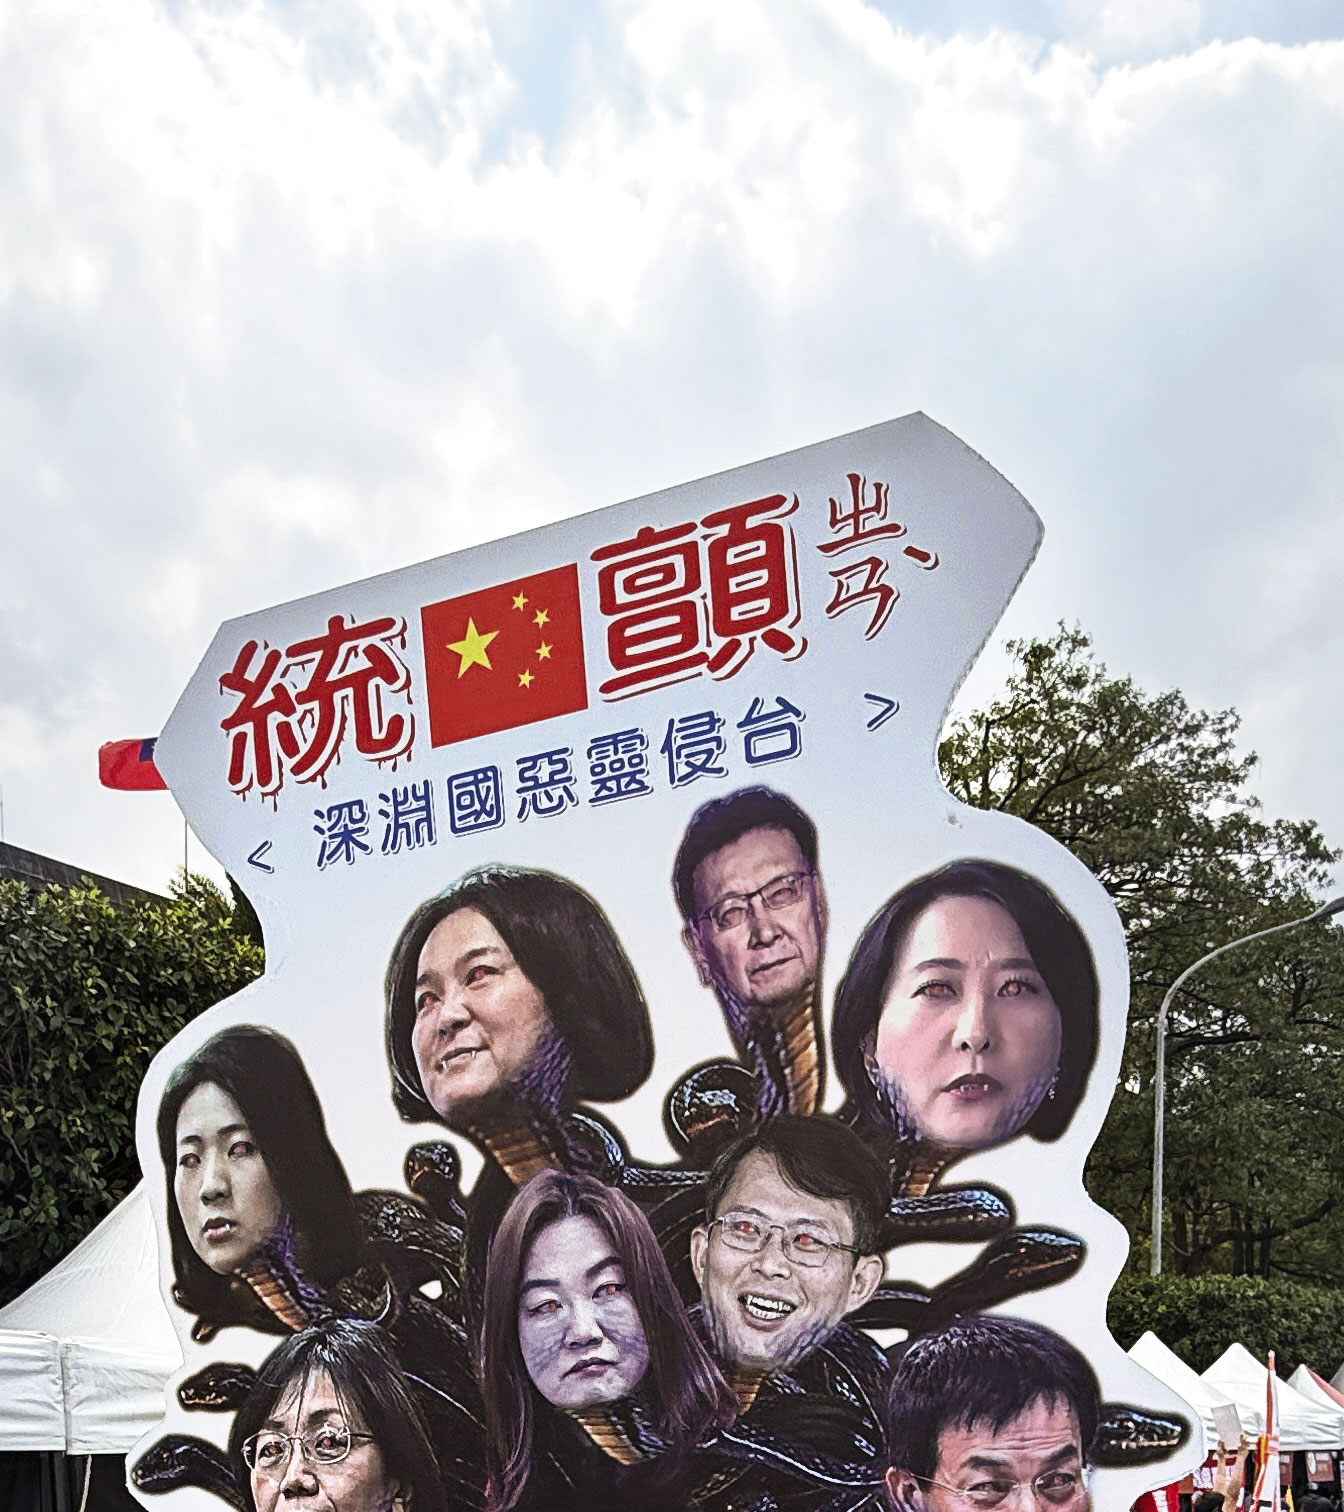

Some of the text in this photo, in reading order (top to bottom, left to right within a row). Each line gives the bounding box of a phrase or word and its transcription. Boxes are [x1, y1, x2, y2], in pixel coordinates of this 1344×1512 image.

[220, 614, 414, 806] 統
[312, 694, 805, 872] 深淵國惡靈侵台
